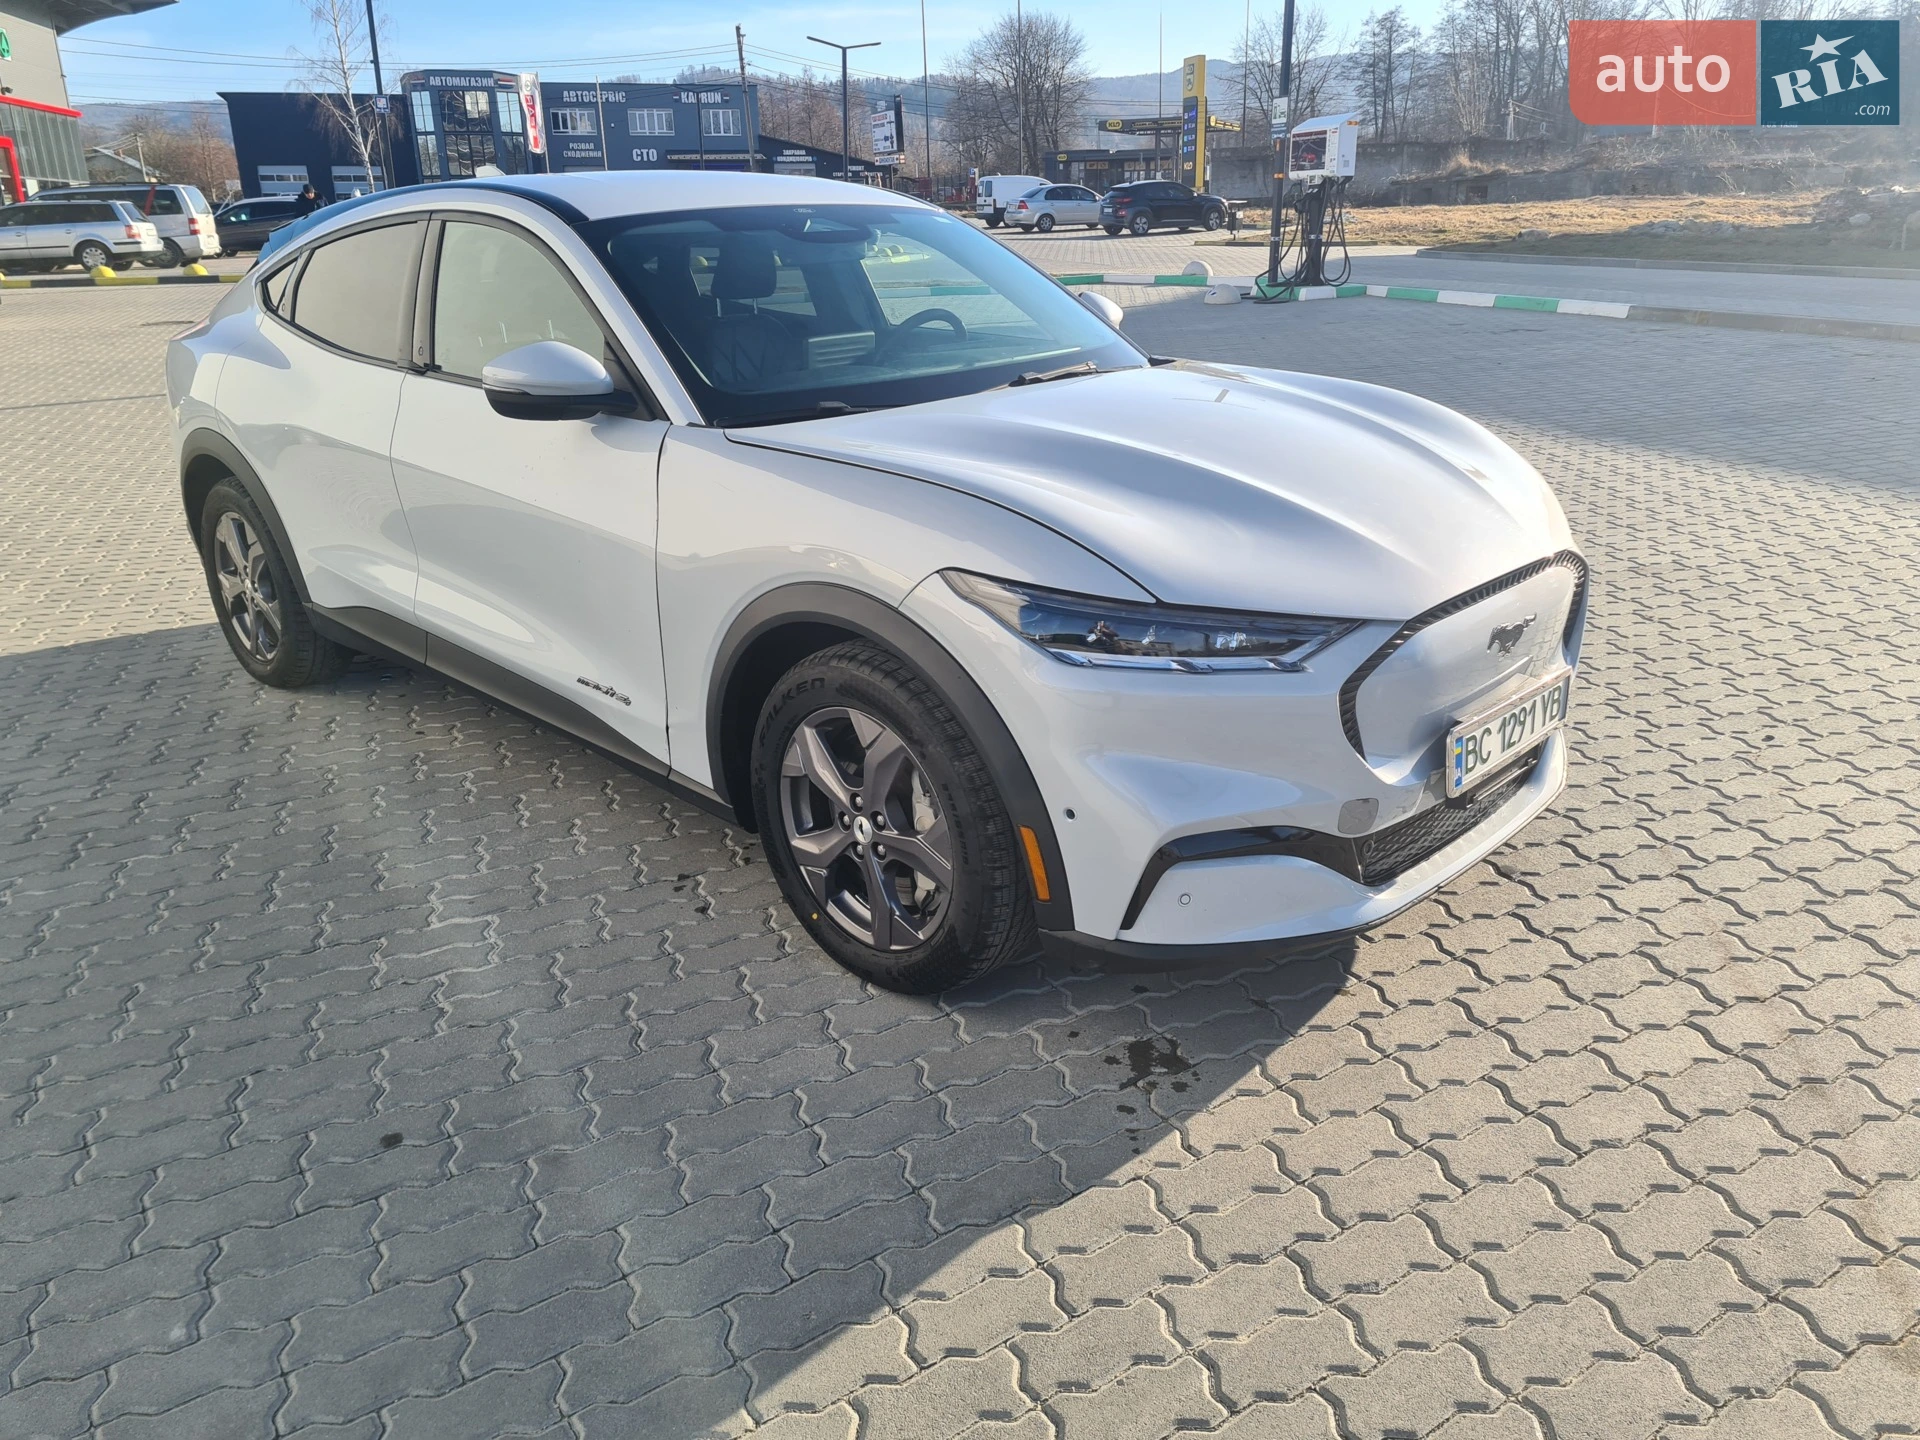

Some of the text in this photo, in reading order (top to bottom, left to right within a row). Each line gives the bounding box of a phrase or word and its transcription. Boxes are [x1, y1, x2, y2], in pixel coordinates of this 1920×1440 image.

[429, 76, 494, 87] АВТОМАГАЗИН
[569, 142, 594, 150] РОЗВАЛ
[632, 148, 658, 162] СТО
[1464, 684, 1562, 775] BC 1291 YB
